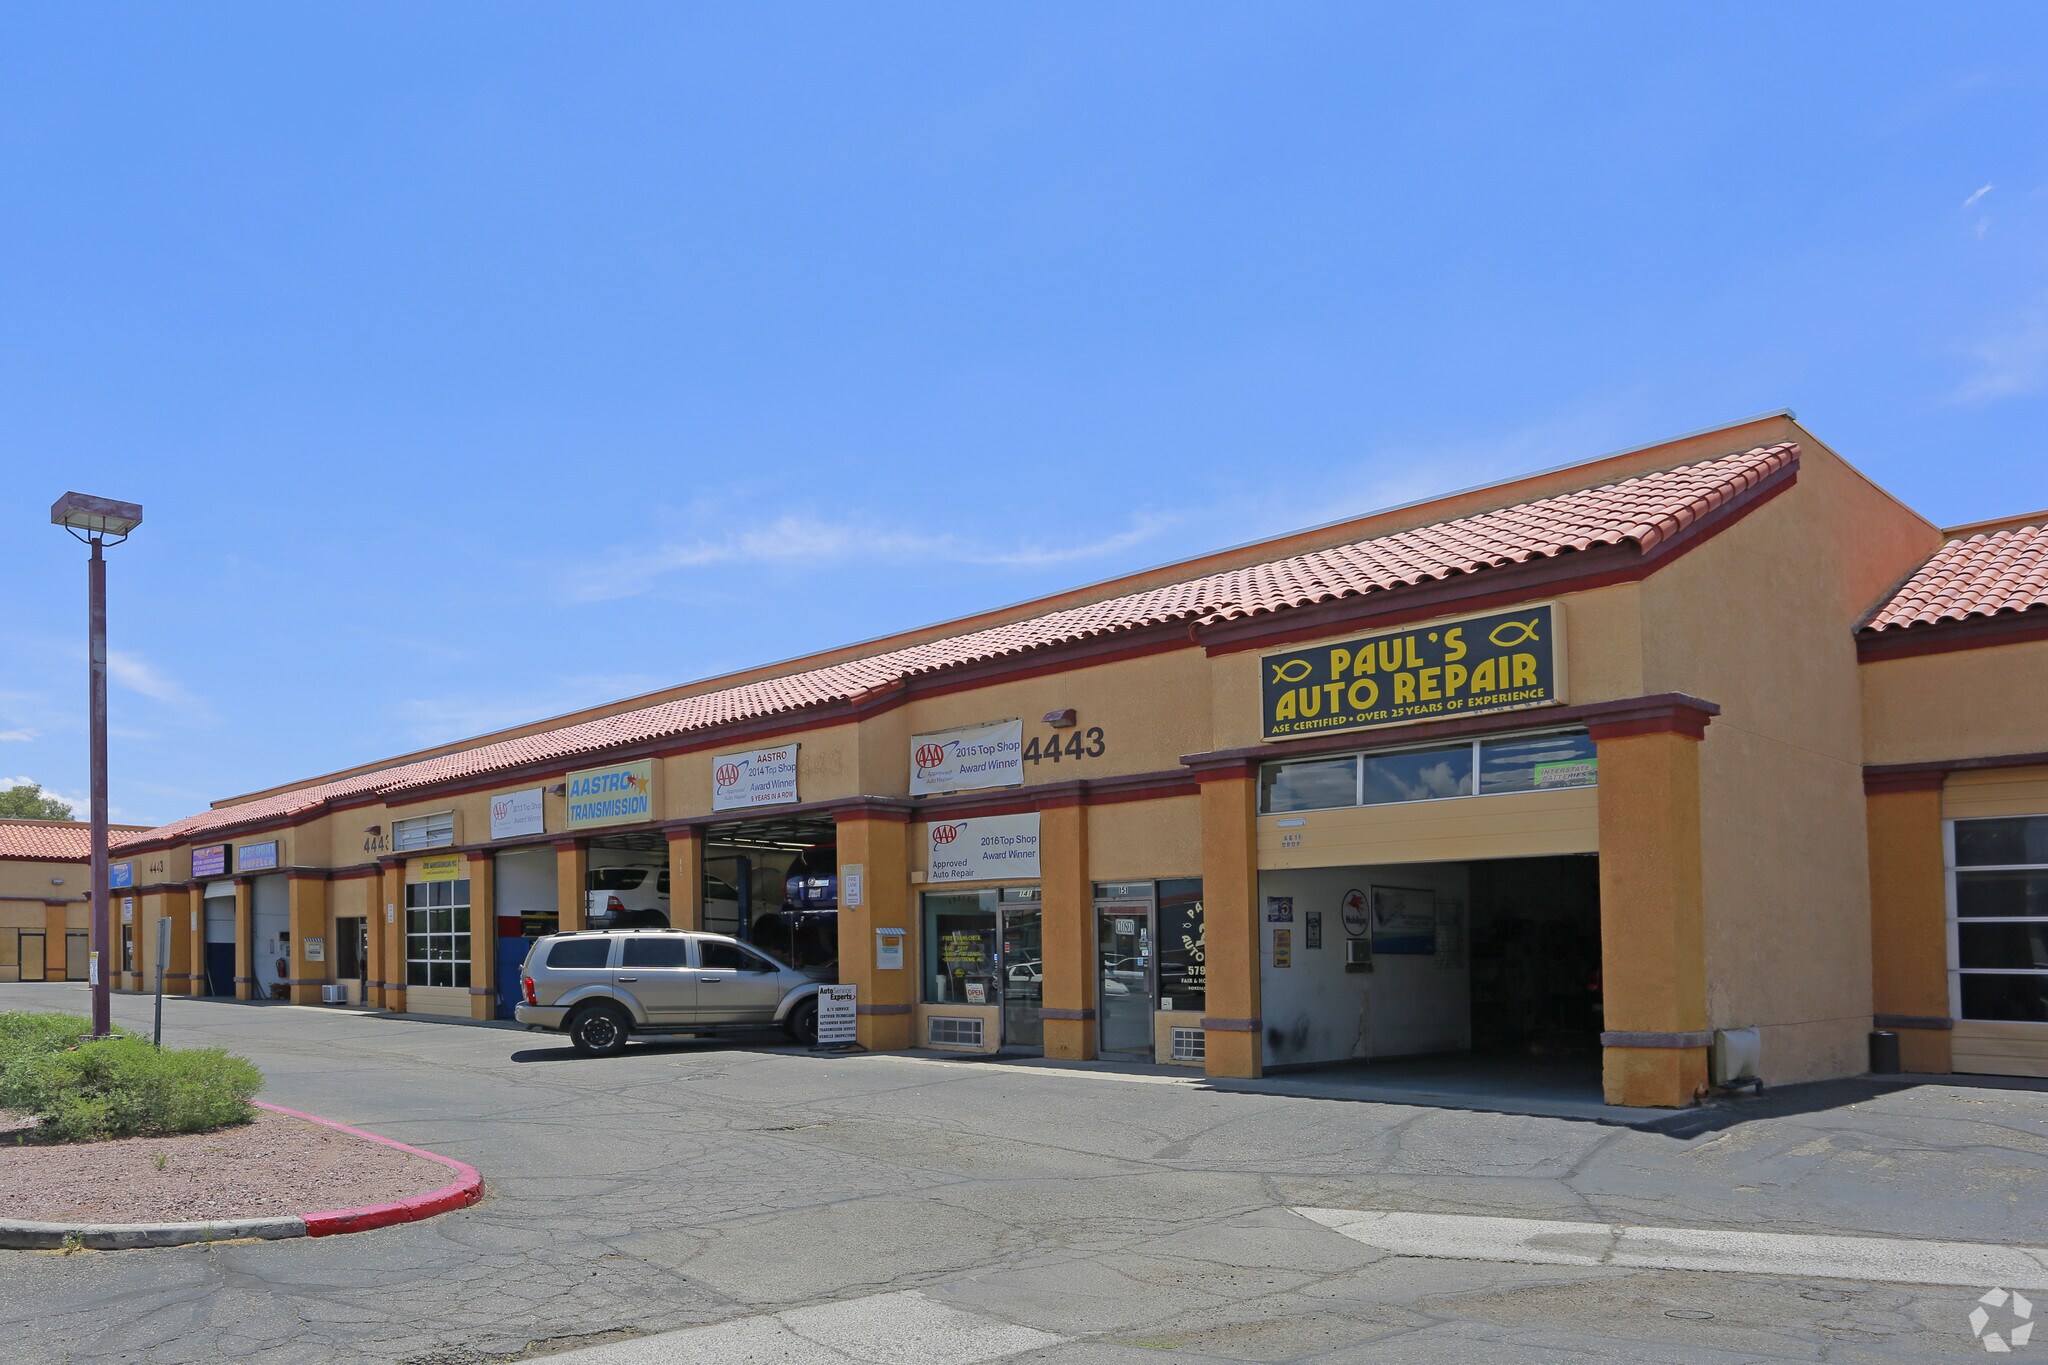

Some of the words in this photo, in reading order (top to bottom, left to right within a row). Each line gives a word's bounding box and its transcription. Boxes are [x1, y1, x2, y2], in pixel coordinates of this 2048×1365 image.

[1331, 627, 1467, 680] PAUL'S
[1276, 678, 1379, 721] AUTO
[1394, 653, 1537, 704] REPAIR
[1271, 723, 1290, 734] ASE
[1293, 716, 1347, 731] CERTIFIED
[1356, 710, 1388, 722] OVER
[1391, 707, 1404, 718] 25
[1405, 702, 1443, 716] YEARS
[1447, 699, 1464, 710] OF
[1468, 687, 1545, 706] EXPERIENCE
[956, 747, 976, 758] 2015
[978, 744, 995, 756] Top
[997, 740, 1020, 753] Shop
[1024, 726, 1106, 766] 4443
[757, 751, 787, 763] AASTRO
[916, 744, 944, 768] AAA
[749, 767, 764, 777] 2014
[765, 766, 776, 775] Top
[778, 764, 796, 773] Shop
[927, 769, 952, 778] Approved
[959, 763, 987, 774] Award
[988, 758, 1019, 770] Winner
[1541, 765, 1590, 775] INTERSTATE
[716, 763, 739, 786] AAA
[936, 776, 954, 784] Repair
[1542, 772, 1586, 781] BATTERIES
[570, 771, 631, 797] AASTRO
[750, 782, 770, 791] Award
[772, 780, 795, 789] Winner
[570, 796, 647, 821] TRANSMISSION
[933, 825, 957, 844] AAA
[981, 837, 999, 846] 2016
[1000, 836, 1014, 846] Top
[1016, 835, 1037, 845] Shop
[982, 851, 1006, 860] Award
[1009, 850, 1036, 859] Winner
[933, 858, 968, 869] Approved
[933, 870, 949, 878] Auto
[951, 869, 974, 878] Repair
[1182, 935, 1204, 962] AUTO
